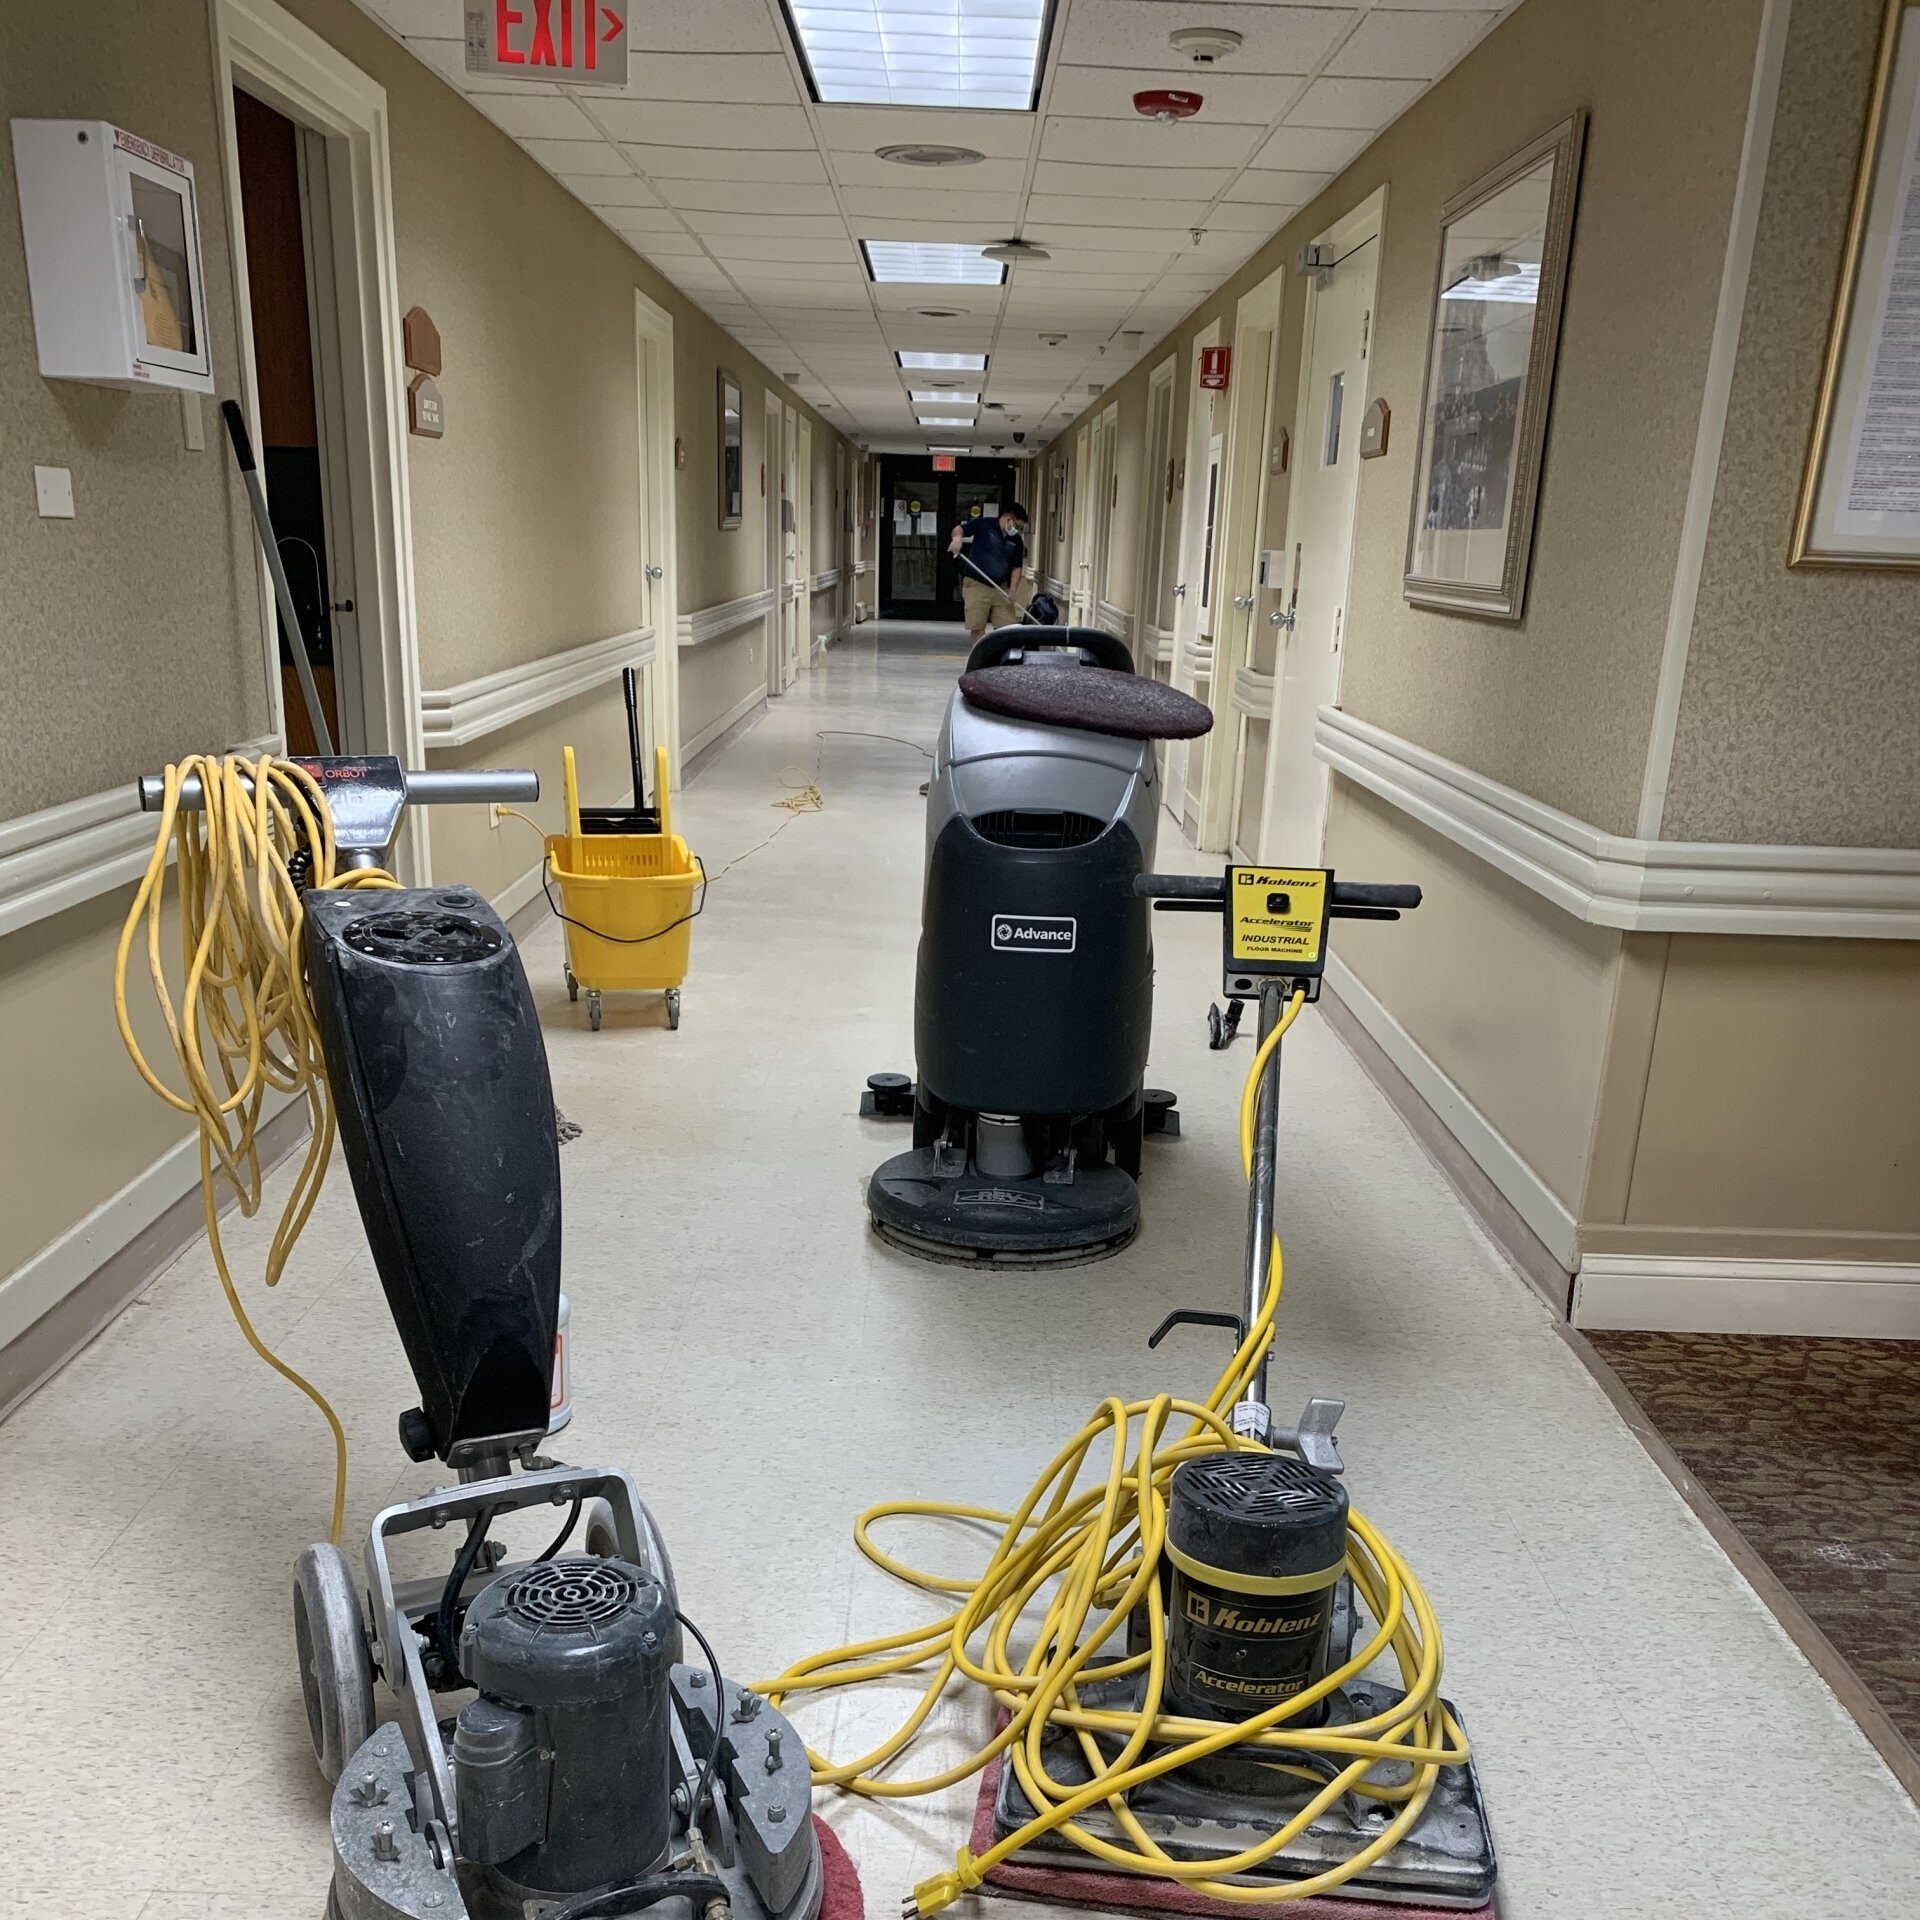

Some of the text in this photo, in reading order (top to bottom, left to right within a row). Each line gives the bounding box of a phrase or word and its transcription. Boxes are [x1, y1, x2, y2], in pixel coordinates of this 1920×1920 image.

[325, 769, 366, 779] ORBOT
[1256, 875, 1319, 888] Koblenz
[1240, 916, 1314, 927] Accelerator
[1013, 927, 1072, 941] Advance
[1242, 934, 1309, 946] INDUSTRIAL
[978, 1190, 1022, 1203] REV
[1214, 1606, 1322, 1634] Koblenz
[1194, 1669, 1305, 1695] Accelerator
